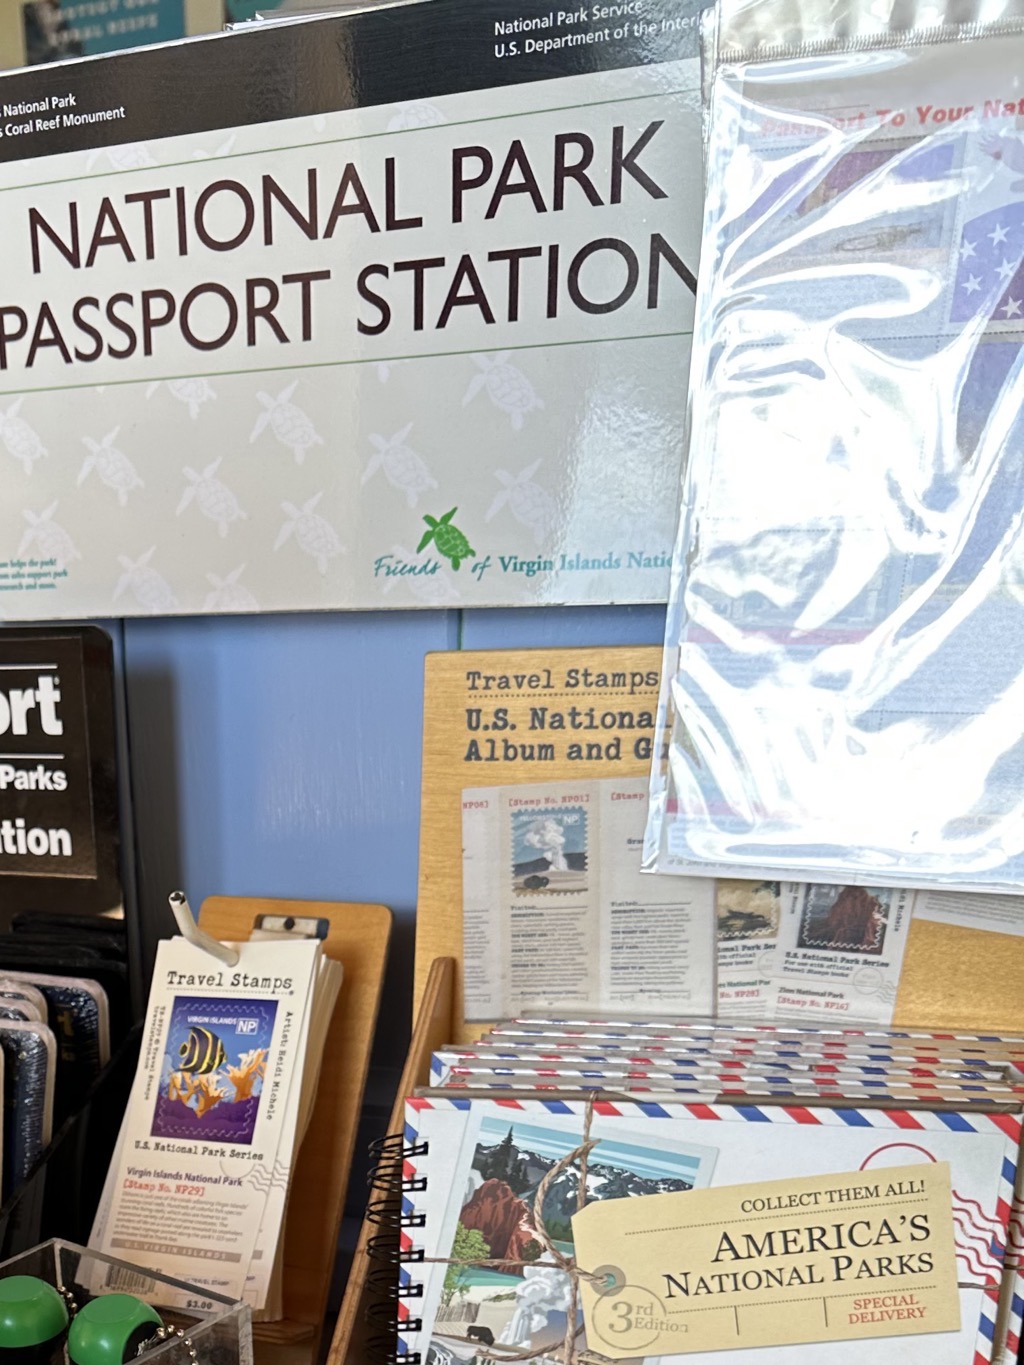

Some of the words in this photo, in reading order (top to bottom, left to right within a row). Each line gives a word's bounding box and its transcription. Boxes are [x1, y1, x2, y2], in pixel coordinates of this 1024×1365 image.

[494, 12, 553, 36] National
[557, 8, 588, 25] Park
[592, 0, 643, 20] Service
[494, 41, 521, 58] U.S.
[525, 29, 610, 54] Department
[613, 24, 630, 40] of
[633, 20, 658, 37] the
[661, 12, 703, 32] Interi
[3, 97, 49, 117] National
[51, 93, 77, 109] Park
[916, 105, 974, 124] Your
[5, 120, 34, 137] Coral
[36, 115, 61, 131] Reef
[63, 106, 126, 126] Monument
[28, 157, 422, 274] NATIONAL
[451, 120, 668, 223] PARK
[374, 554, 442, 577] Friends
[471, 556, 492, 581] of
[498, 554, 553, 576] Virgin
[559, 552, 621, 571] Islands
[627, 550, 674, 569] Natio
[467, 669, 555, 691] Travel
[565, 667, 660, 700] Stamps
[466, 707, 517, 731] U.S.
[465, 738, 555, 762] Album
[566, 738, 622, 761] and
[167, 971, 224, 987] Travel
[230, 973, 293, 994] Stamps
[796, 988, 827, 998] National
[827, 991, 844, 999] Park
[187, 1015, 210, 1024] VIRGIN
[210, 1016, 237, 1025] ISLANDS
[238, 1020, 256, 1033] NP
[135, 1140, 150, 1151] U.S.
[154, 1142, 198, 1155] National
[201, 1147, 226, 1157] Park
[229, 1150, 264, 1161] Series
[123, 1179, 154, 1192] [Stamp
[158, 1182, 172, 1193] No.
[175, 1184, 205, 1197] NP29]
[127, 1166, 152, 1178] Virgin
[153, 1170, 183, 1181] Islands
[184, 1173, 221, 1185] National
[223, 1176, 243, 1187] Park
[741, 1193, 820, 1213] COLLECT
[824, 1186, 880, 1203] THEM
[884, 1179, 925, 1197] ALL!
[710, 1214, 931, 1263] AMERICA'S
[662, 1264, 824, 1299] NATIONAL
[831, 1252, 934, 1282] PARKS
[186, 1300, 213, 1309] $3.00
[853, 1294, 920, 1310] SPECIAL
[611, 1302, 654, 1334] 3rd
[634, 1318, 689, 1334] Edition
[848, 1307, 927, 1325] DELIVERY
